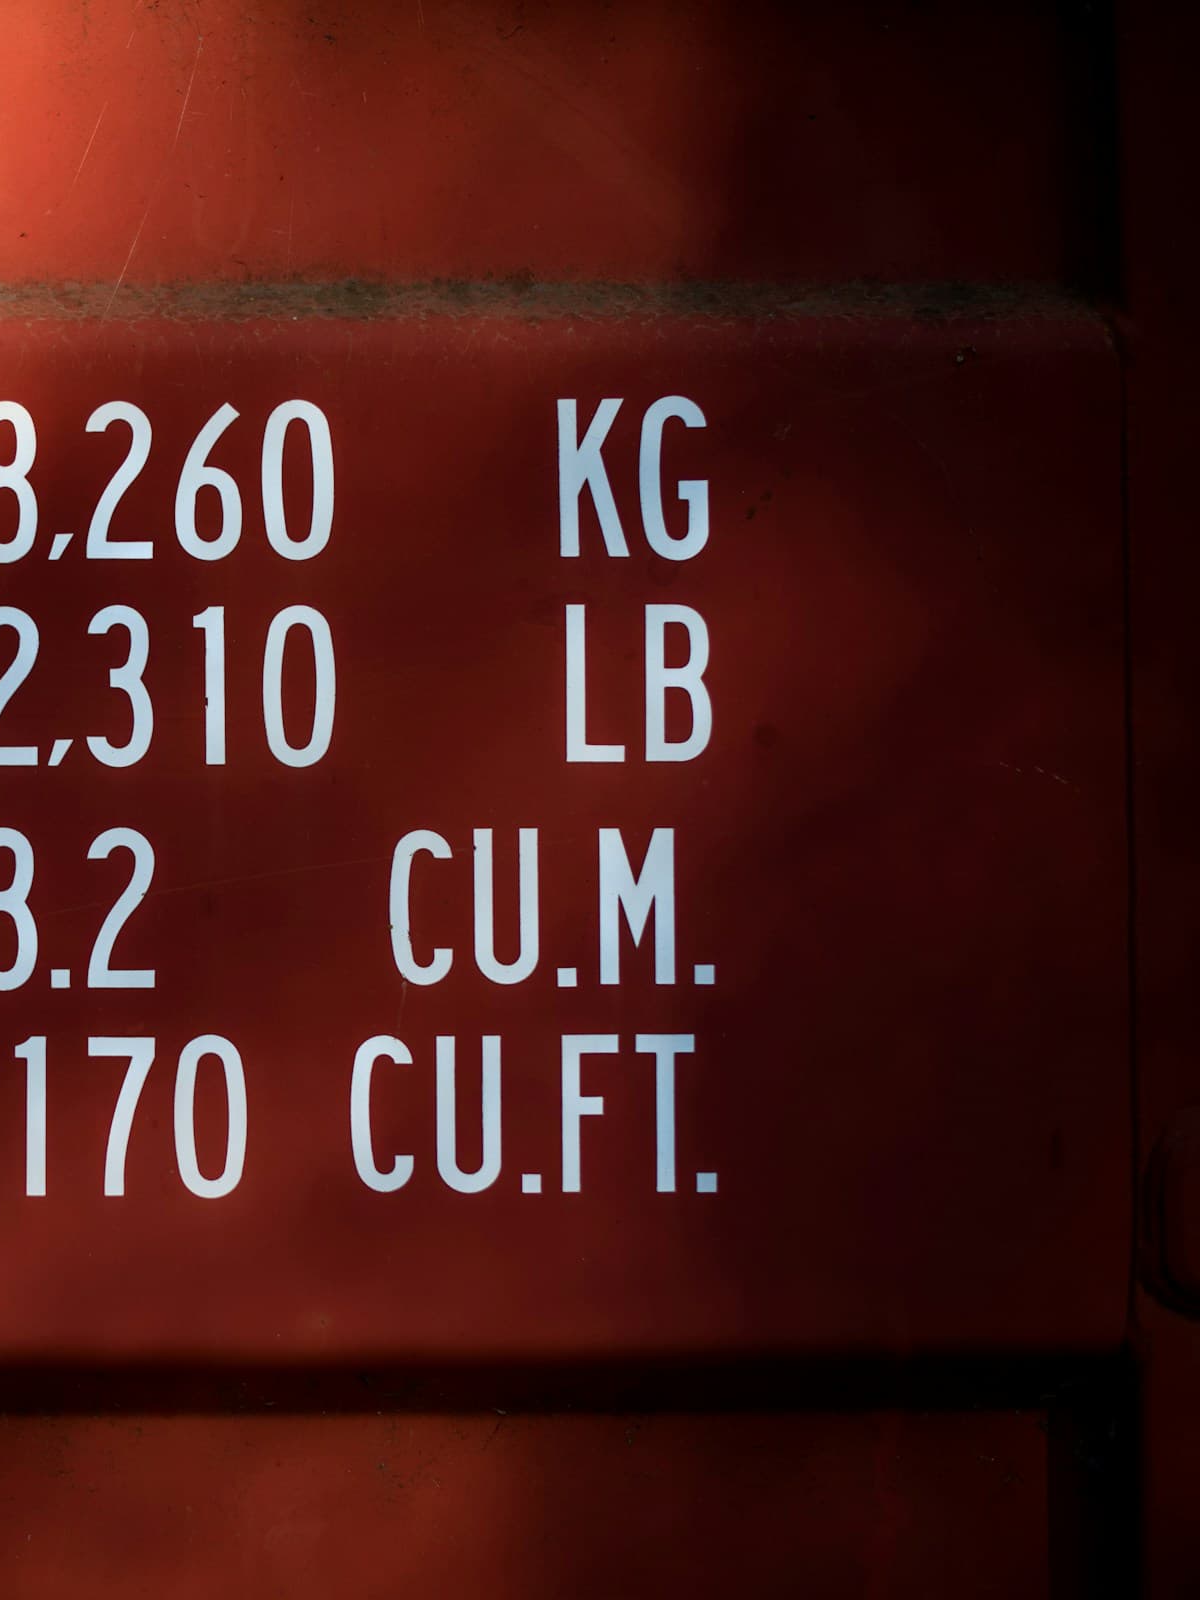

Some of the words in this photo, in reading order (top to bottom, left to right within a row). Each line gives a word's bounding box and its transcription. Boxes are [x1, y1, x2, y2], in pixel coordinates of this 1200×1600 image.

[558, 396, 710, 560] KG
[566, 604, 713, 762] LB
[390, 828, 715, 985] CU.M.
[351, 1034, 717, 1194] CU.FT.
